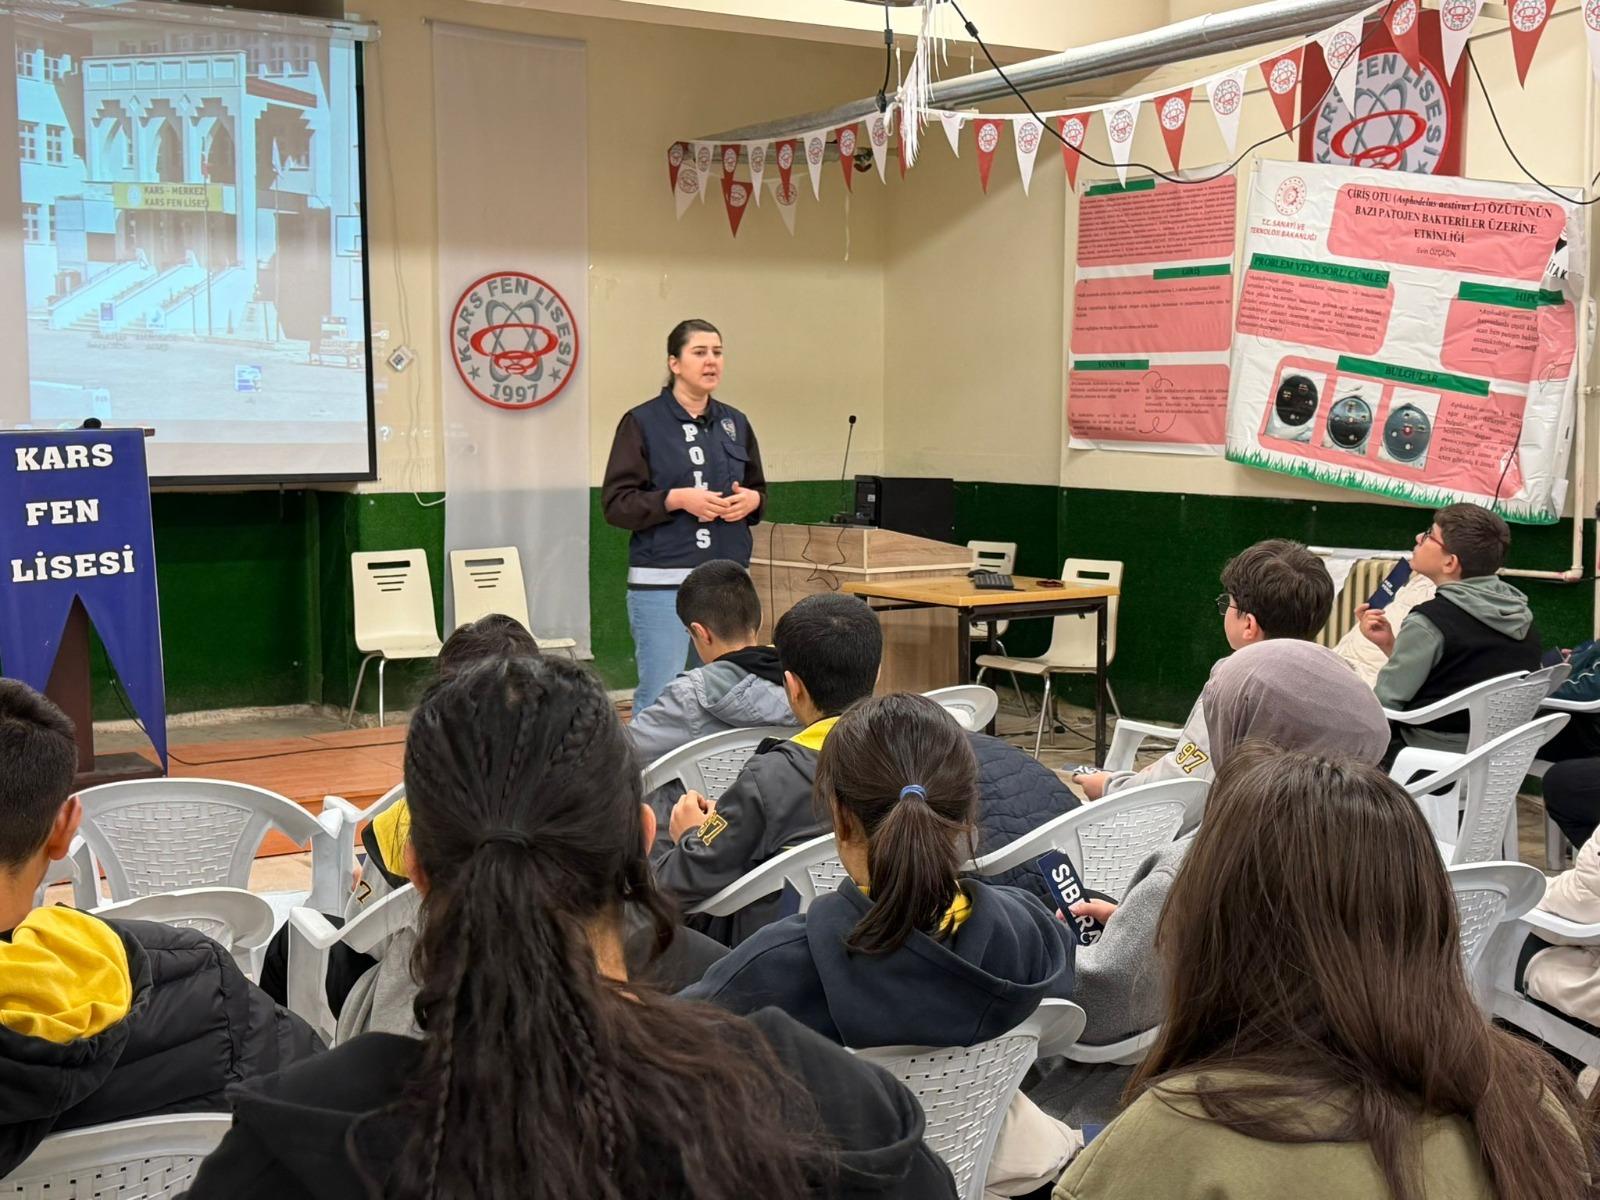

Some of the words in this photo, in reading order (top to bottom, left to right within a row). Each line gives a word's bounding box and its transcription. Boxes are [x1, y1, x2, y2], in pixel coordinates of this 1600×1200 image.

[144, 186, 164, 195] KARS
[171, 186, 205, 196] MERKEZ
[144, 198, 165, 207] KARS
[167, 199, 182, 208] FEN
[1347, 187, 1371, 201] ÇİRİŞ
[1372, 190, 1392, 202] OTU
[1488, 202, 1552, 219] ÖZÜTÜNÜN
[1297, 223, 1306, 231] VE
[1355, 205, 1377, 217] BAZI
[1379, 208, 1420, 222] PATOJEN
[1422, 213, 1486, 230] BAKTERİLER
[1488, 218, 1538, 234] ÜZERİNE
[1414, 228, 1465, 243] ETKİNLİĞİ
[1254, 256, 1295, 270] PROBLEM
[1296, 261, 1321, 275] VEYA
[1322, 265, 1346, 278] SORU
[457, 291, 483, 363] KARS
[487, 277, 529, 298] FEN
[1385, 366, 1438, 385] BULGULAR
[490, 383, 539, 403] 1997
[15, 443, 113, 471] KARS
[682, 423, 711, 549] POLS
[26, 499, 99, 526] FEN
[11, 544, 135, 582] LİSESİ
[1176, 742, 1208, 774] 97
